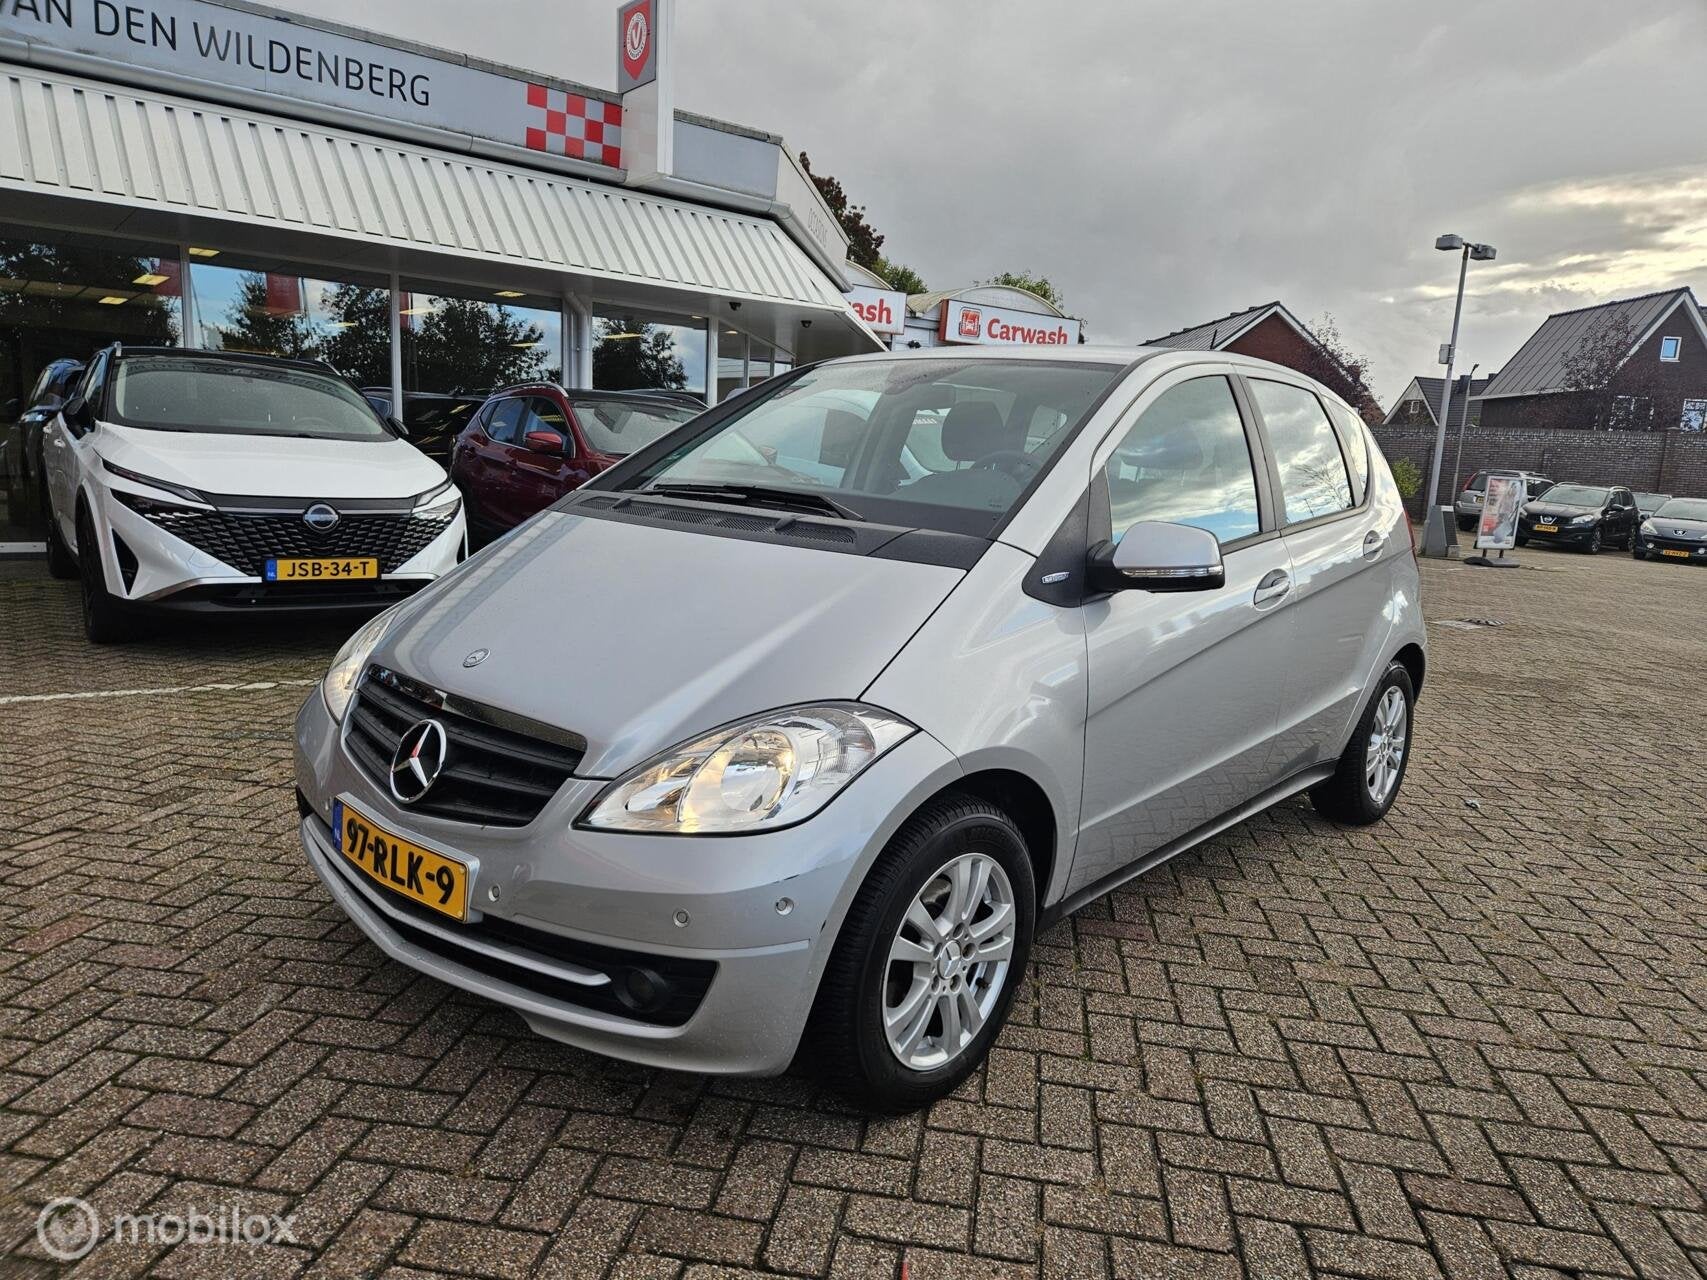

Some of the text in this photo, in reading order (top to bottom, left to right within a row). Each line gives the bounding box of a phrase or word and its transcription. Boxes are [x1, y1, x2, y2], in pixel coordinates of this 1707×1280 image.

[94, 0, 177, 51] DEN
[193, 21, 430, 106] WILDENBERG
[848, 298, 892, 325] ash
[987, 318, 1068, 345] Carwash
[287, 561, 370, 578] JSB-34-T
[346, 817, 455, 906] 97-RLK-9
